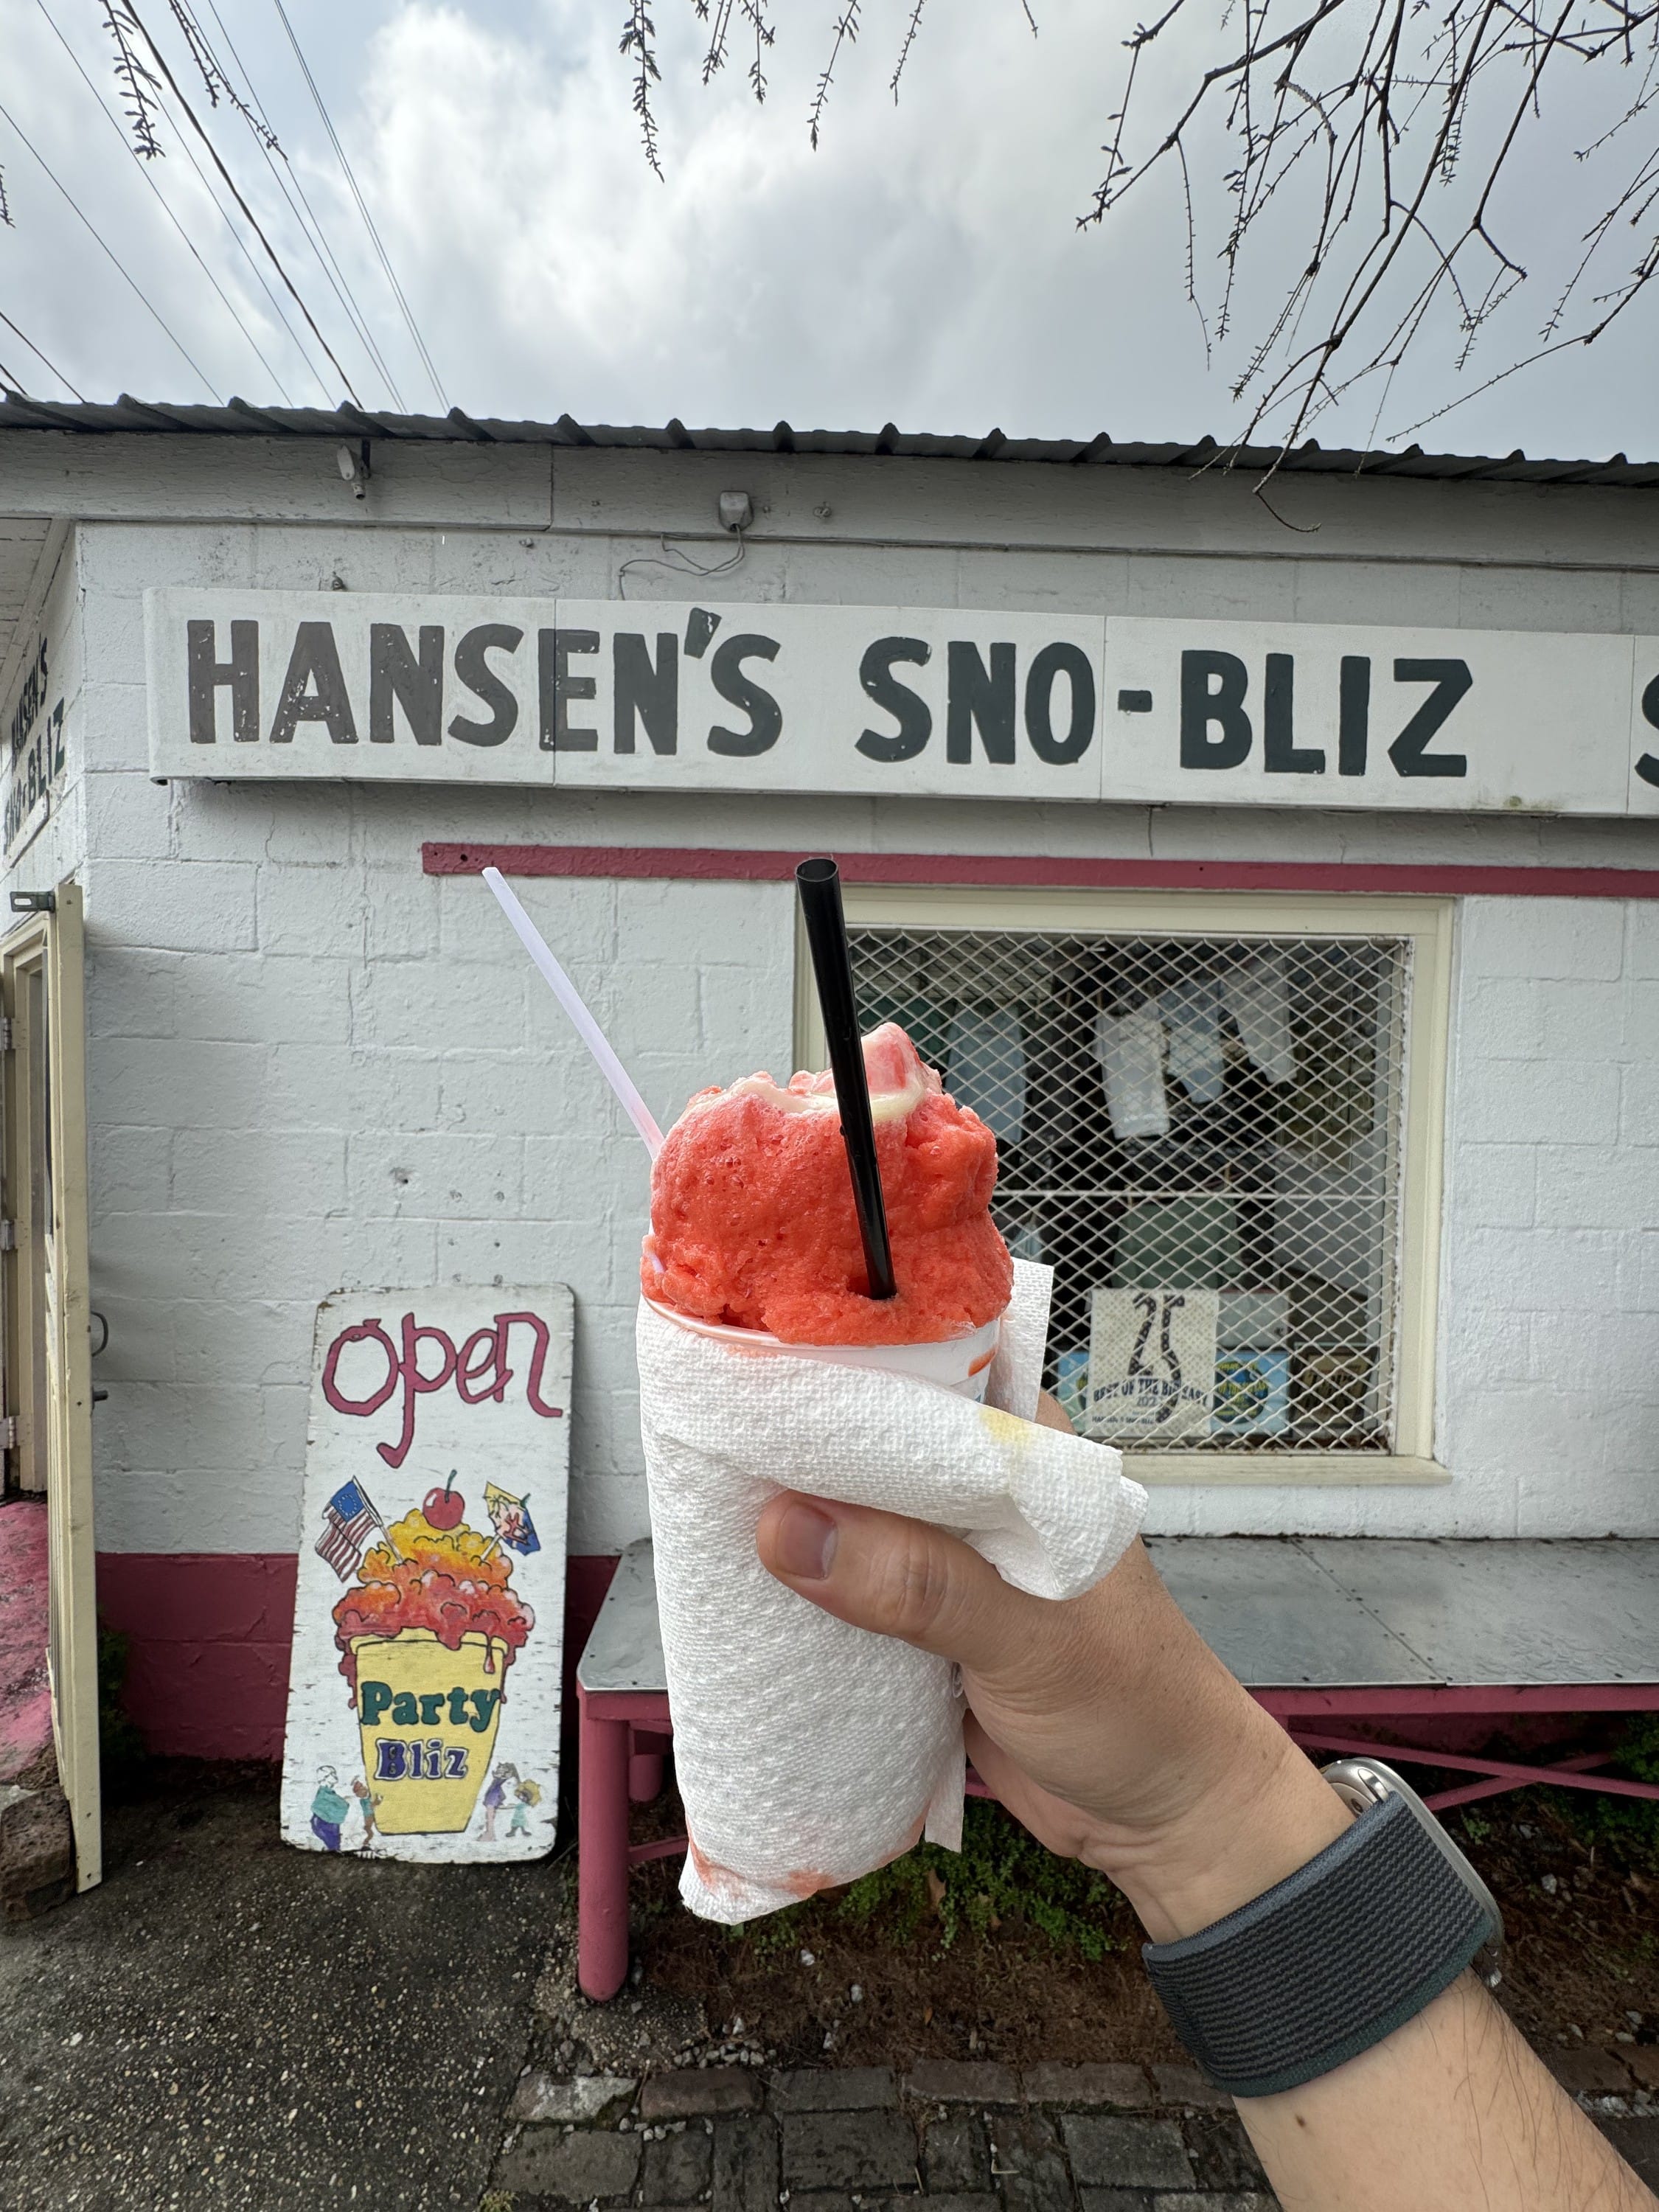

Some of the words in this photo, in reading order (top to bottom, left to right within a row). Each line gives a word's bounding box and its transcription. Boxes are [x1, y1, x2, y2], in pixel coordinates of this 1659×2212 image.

[187, 608, 782, 758] HANSEN'S
[321, 1312, 563, 1469] Open
[360, 1680, 502, 1733] Party
[374, 1738, 468, 1781] Bliz
